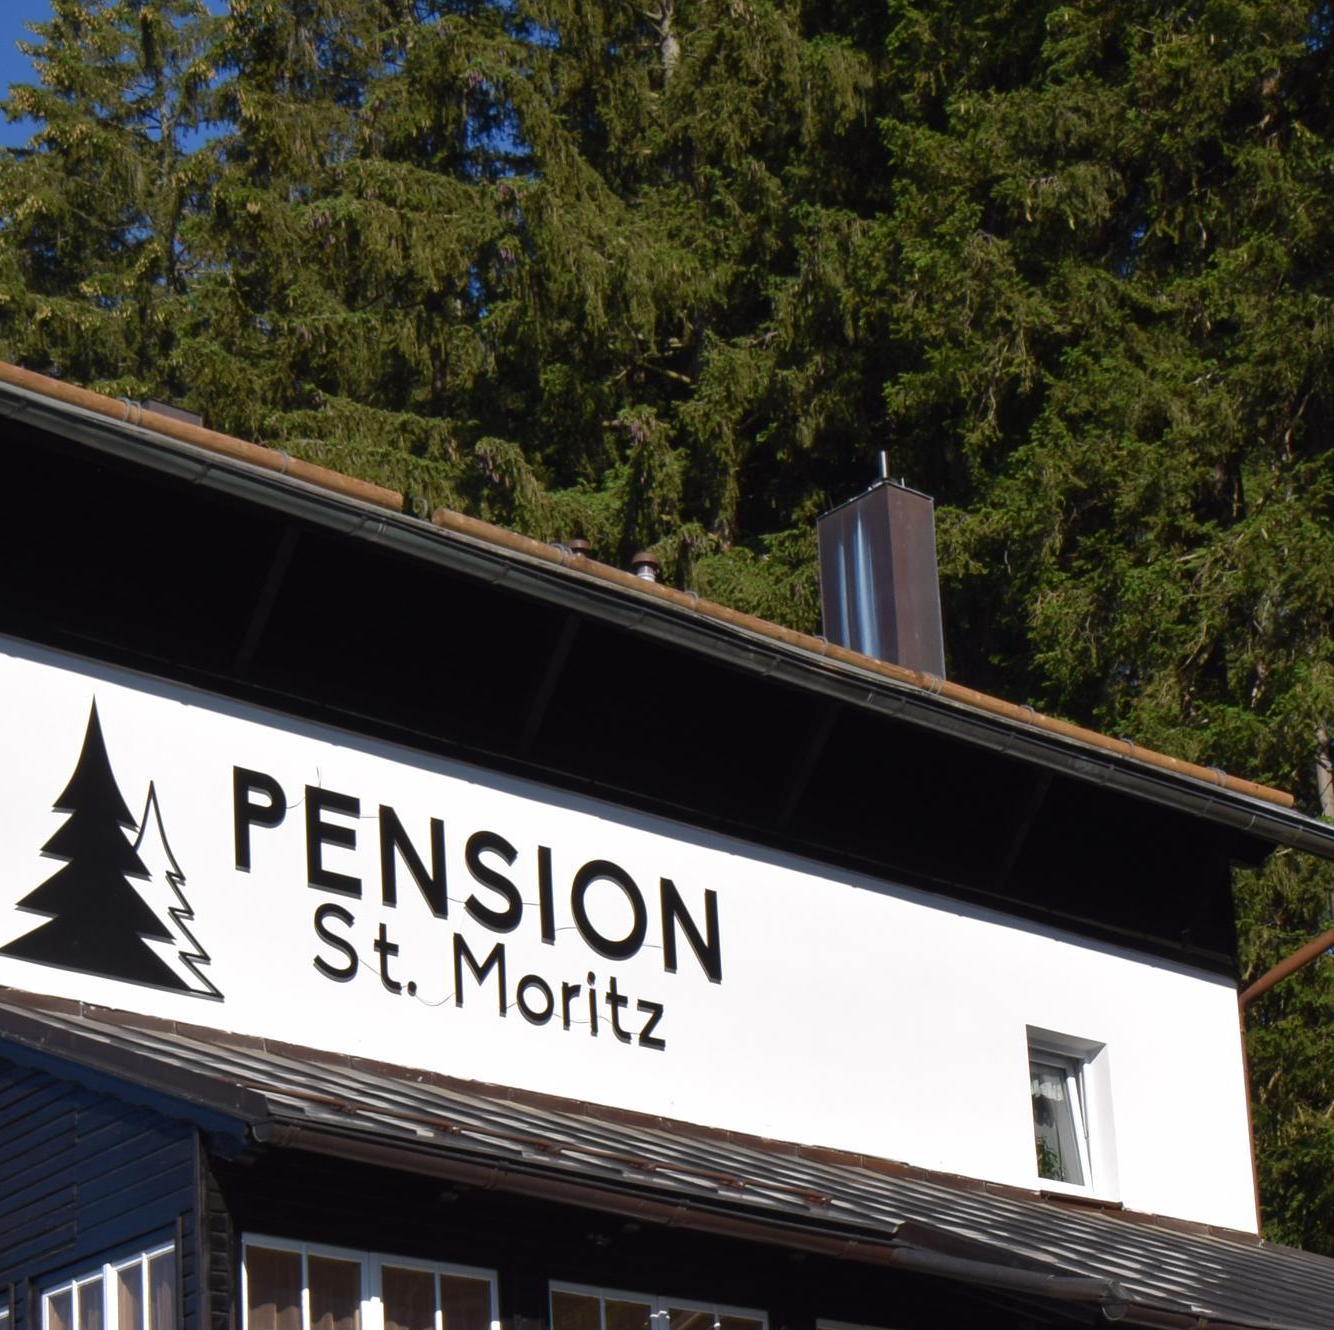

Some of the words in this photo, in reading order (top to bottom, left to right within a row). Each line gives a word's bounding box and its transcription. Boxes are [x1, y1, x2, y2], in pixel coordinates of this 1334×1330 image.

[233, 766, 721, 983] PENSION
[314, 904, 418, 995] St.
[454, 933, 666, 1050] Moritz
